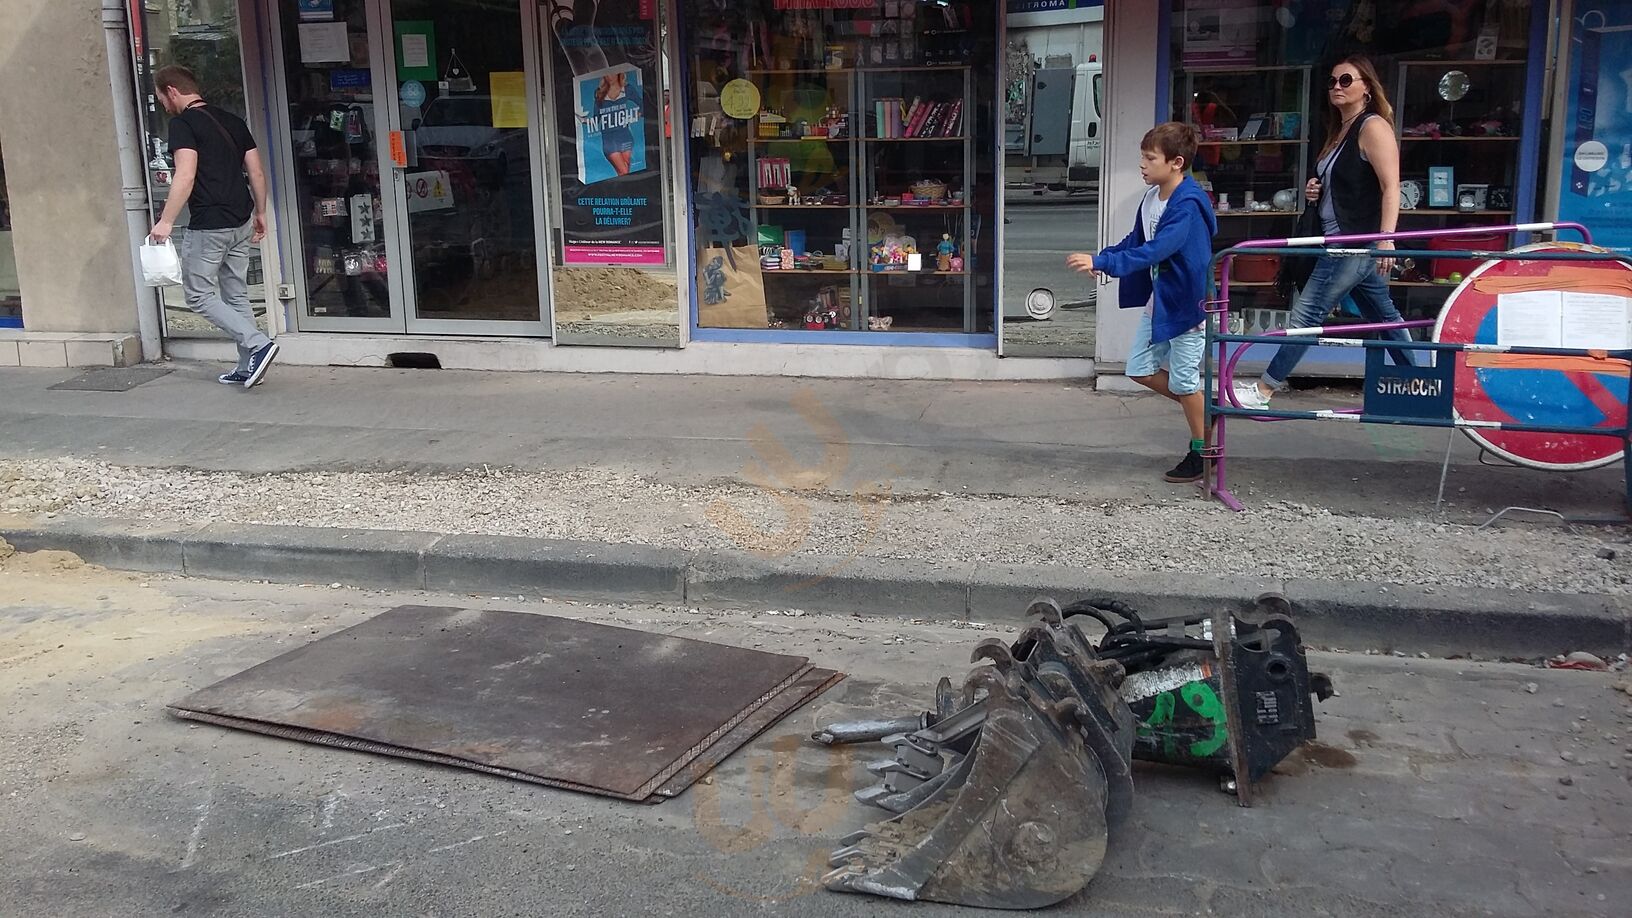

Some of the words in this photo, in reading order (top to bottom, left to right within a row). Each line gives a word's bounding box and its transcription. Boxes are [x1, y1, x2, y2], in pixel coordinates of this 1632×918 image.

[586, 117, 598, 133] IN
[601, 107, 639, 130] FLIGHT
[578, 198, 594, 206] CETTE
[594, 198, 620, 206] RELATION
[592, 207, 632, 215] POURRA-T-ELLE
[595, 217, 603, 225] LA
[603, 216, 632, 225] DÉLIVRER?
[1376, 376, 1442, 397] STRACCHI
